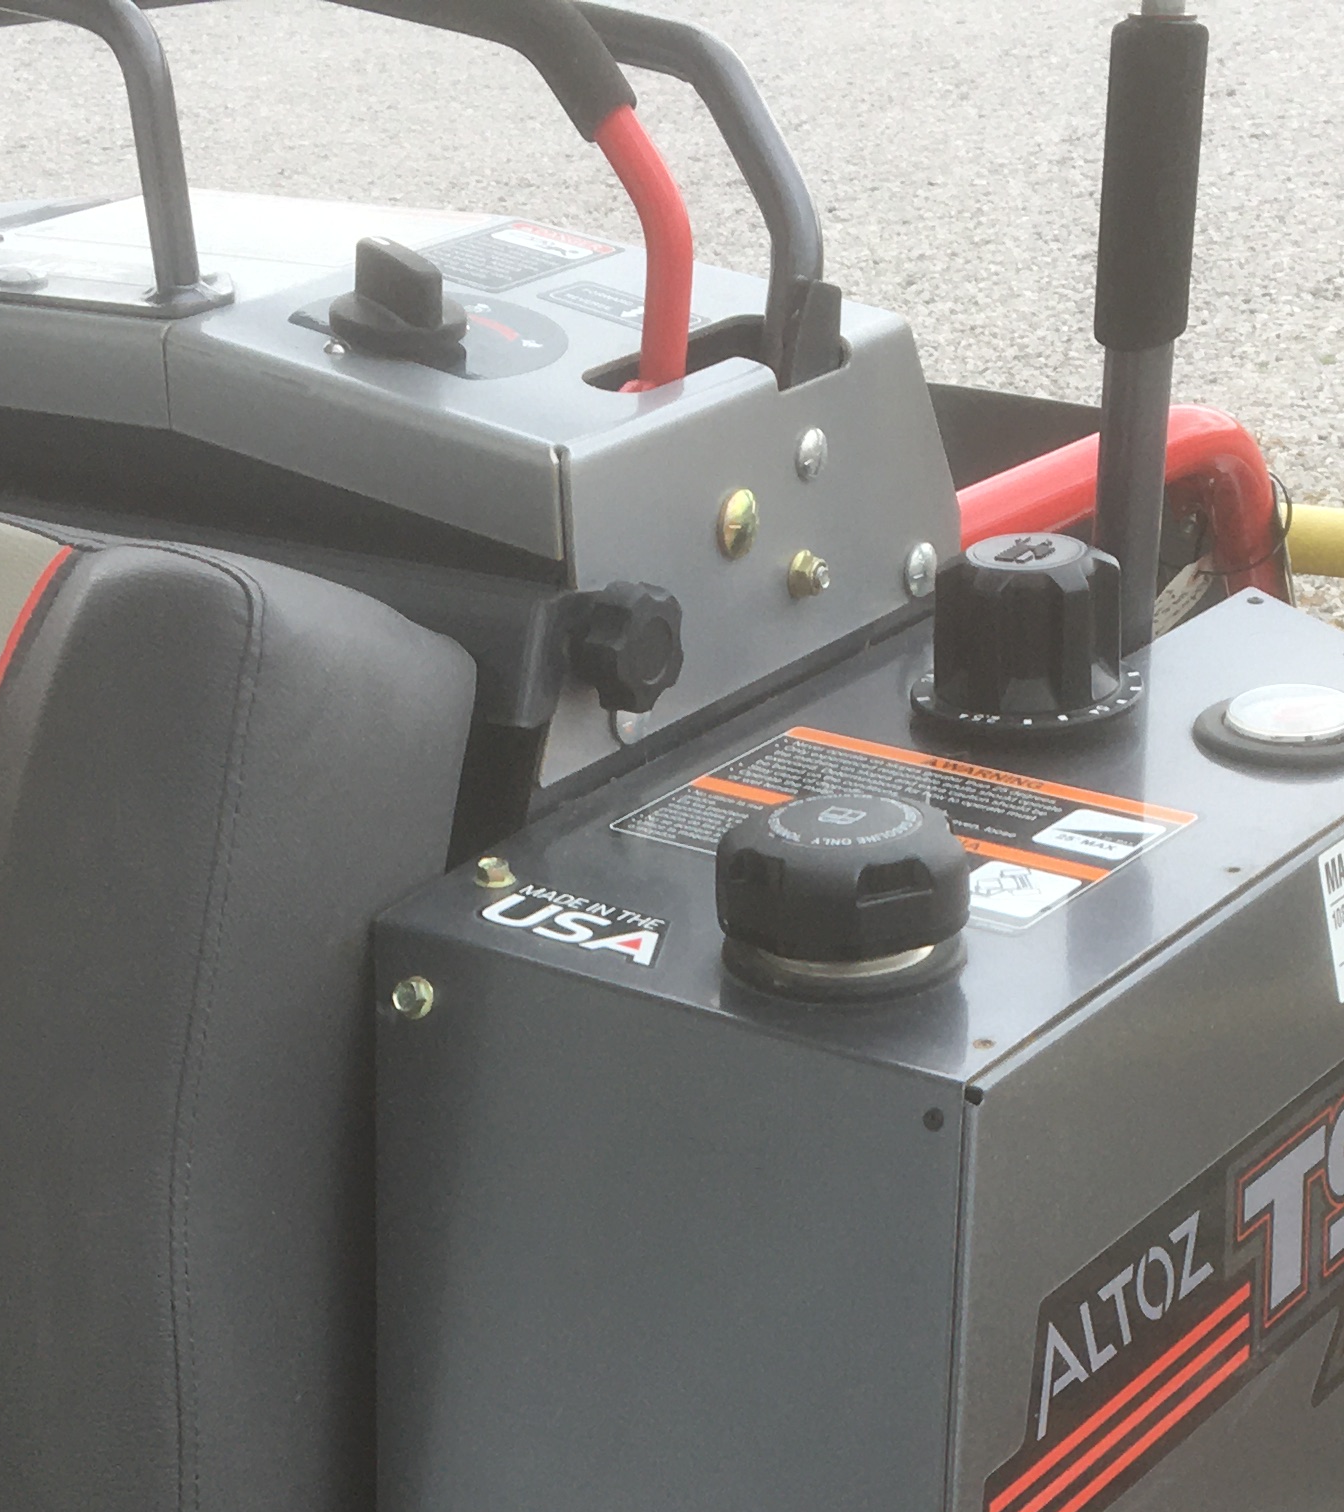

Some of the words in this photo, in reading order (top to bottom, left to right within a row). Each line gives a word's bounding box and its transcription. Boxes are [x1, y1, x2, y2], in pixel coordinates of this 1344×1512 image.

[481, 893, 659, 966] USA
[519, 884, 590, 909] MADE
[585, 902, 616, 917] IN
[615, 909, 666, 930] THE
[1037, 1209, 1215, 1442] ALTOZ
